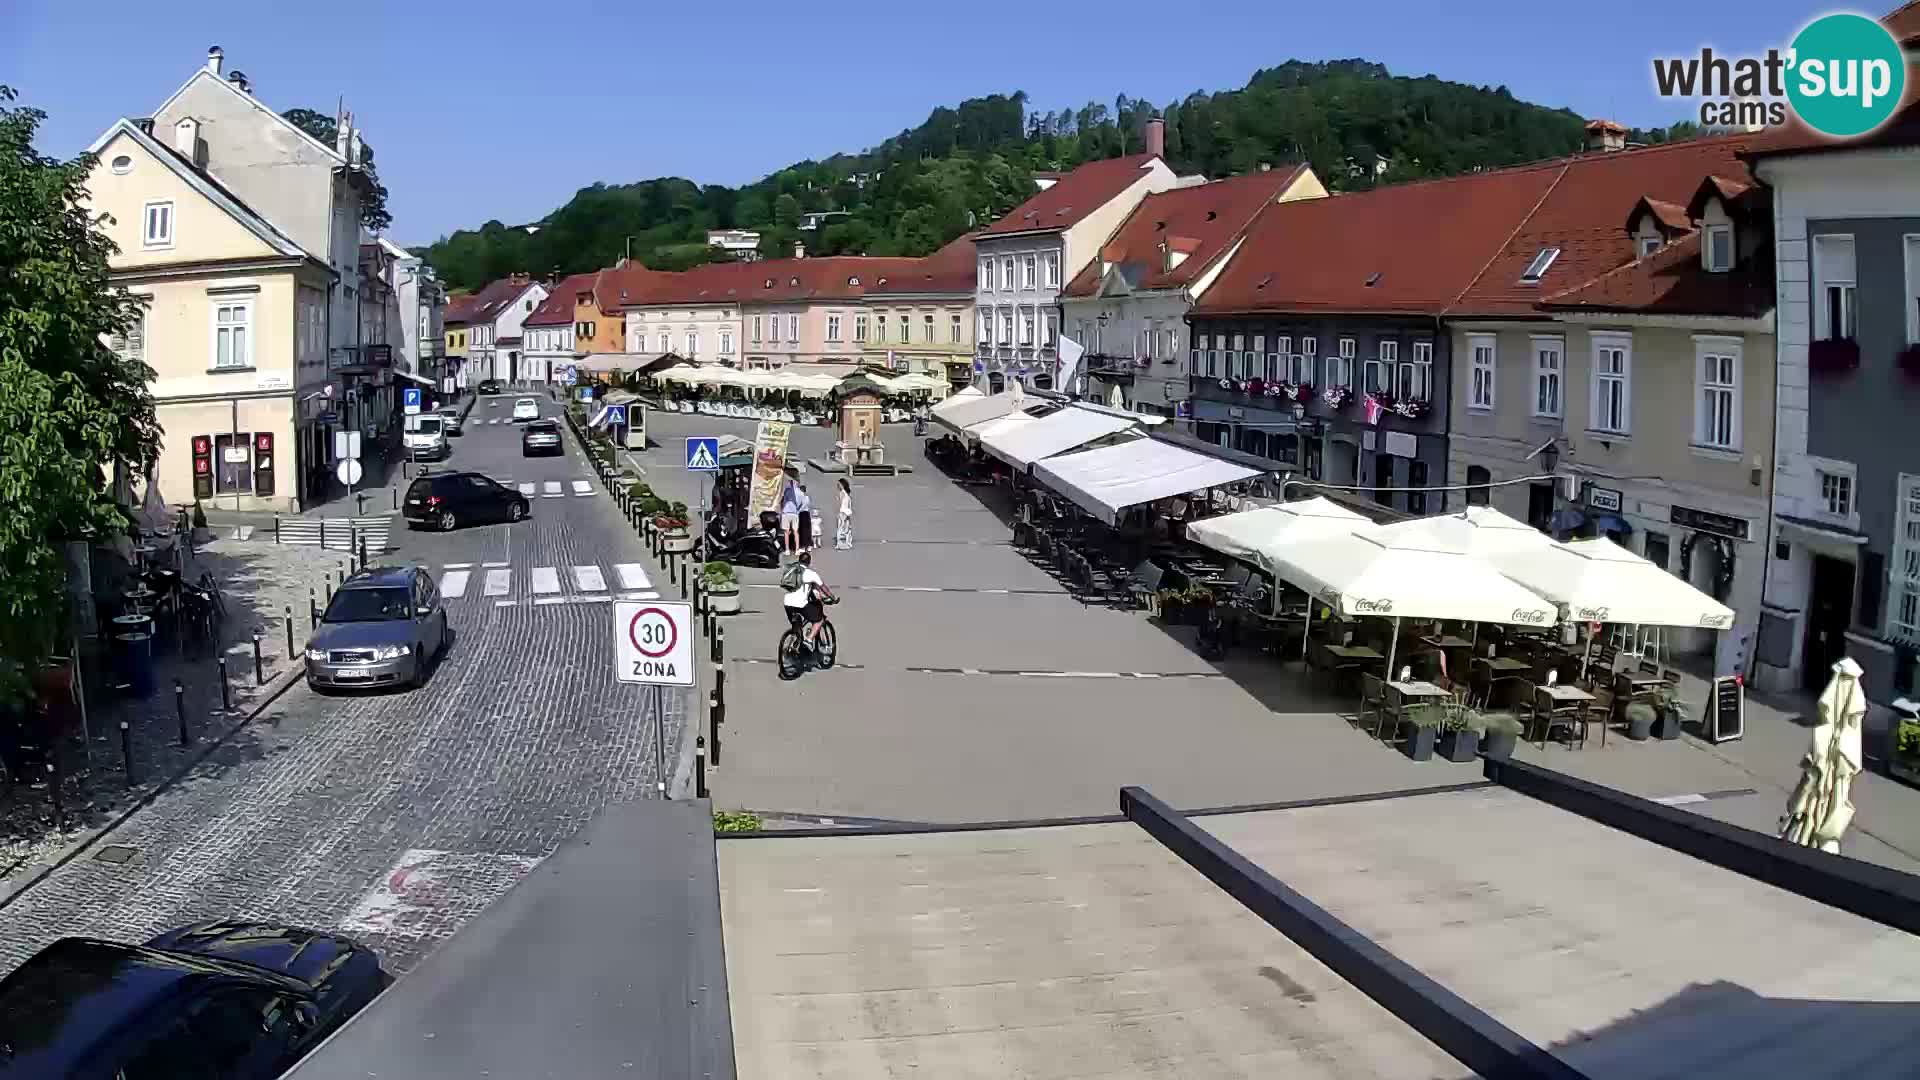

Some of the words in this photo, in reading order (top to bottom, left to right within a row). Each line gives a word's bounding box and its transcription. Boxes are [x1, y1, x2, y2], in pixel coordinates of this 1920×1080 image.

[408, 392, 416, 403] P
[642, 623, 666, 645] 30
[632, 660, 677, 678] ZONA
